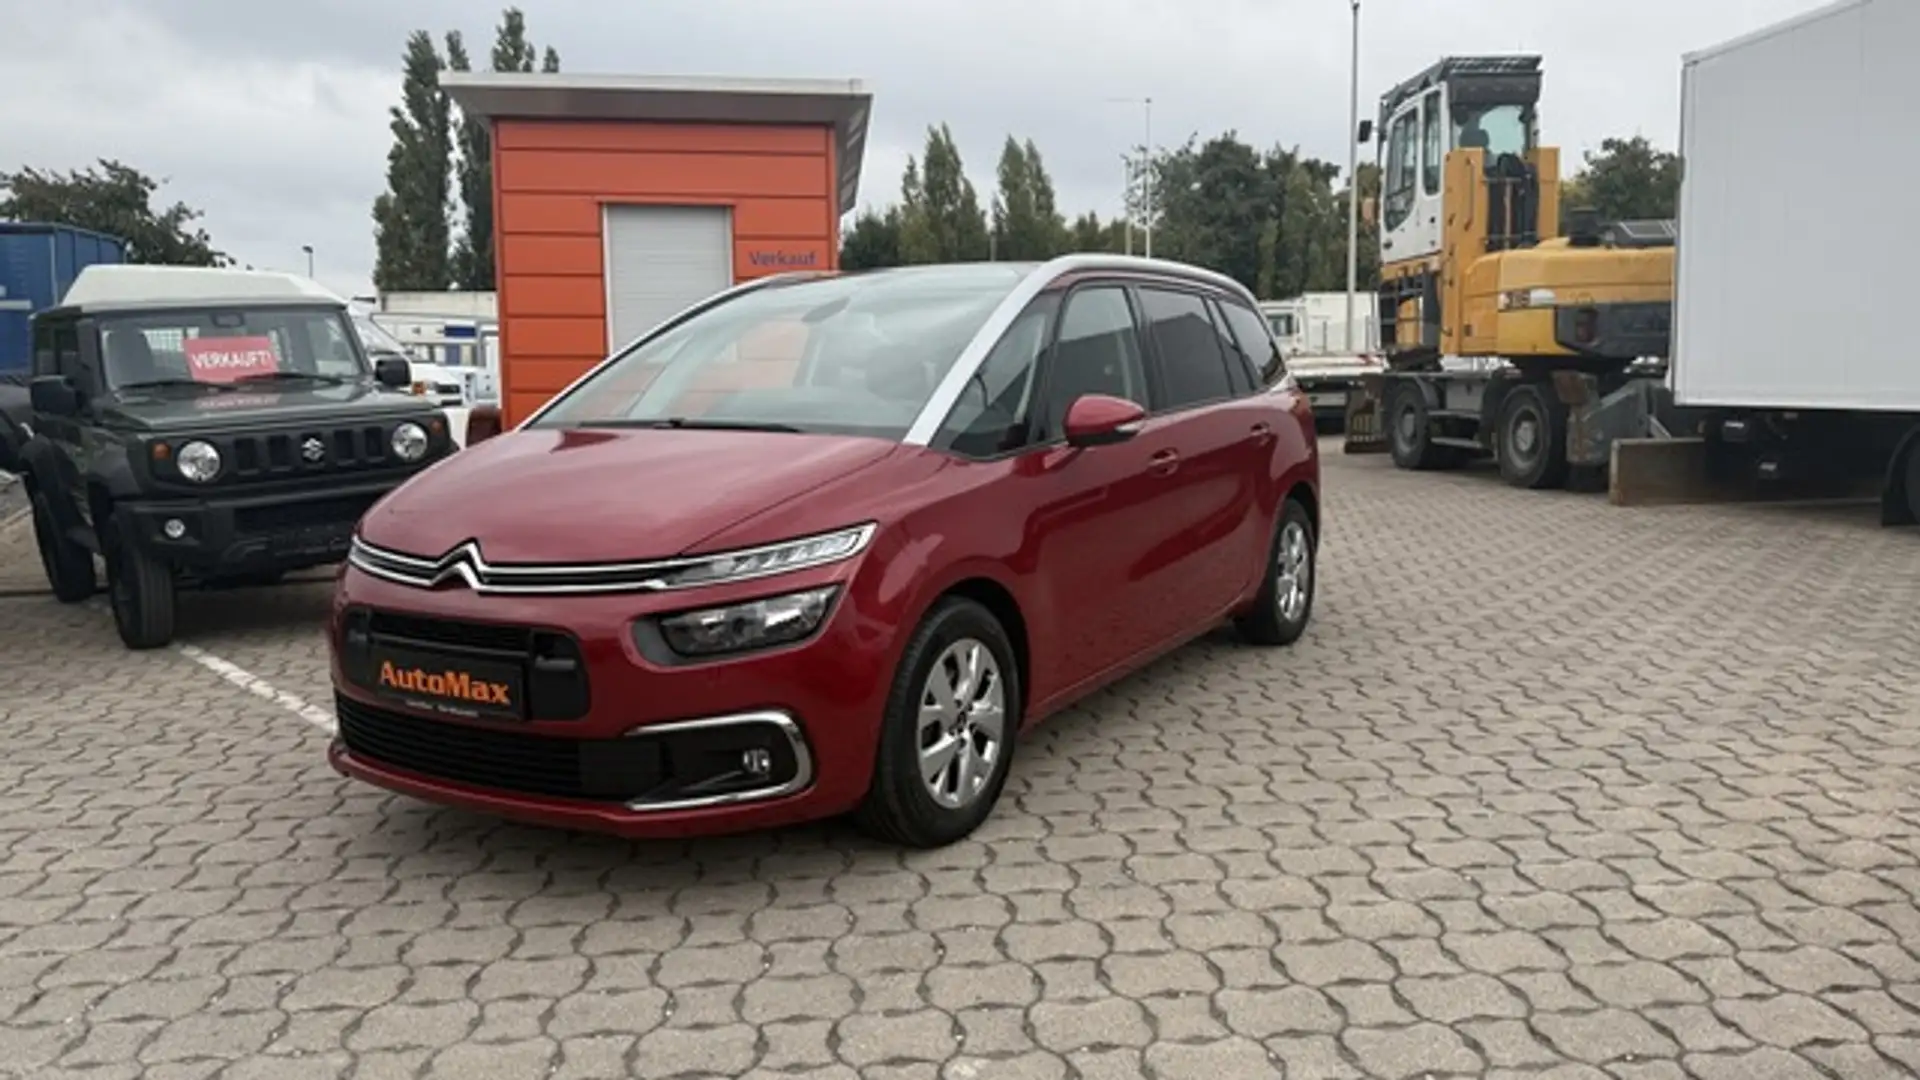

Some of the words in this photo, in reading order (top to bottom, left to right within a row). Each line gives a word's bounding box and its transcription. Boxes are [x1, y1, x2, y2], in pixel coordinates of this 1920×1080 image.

[748, 250, 817, 266] Verkauf
[192, 350, 272, 369] VERKAUFT!
[379, 660, 511, 705] AutoMax
